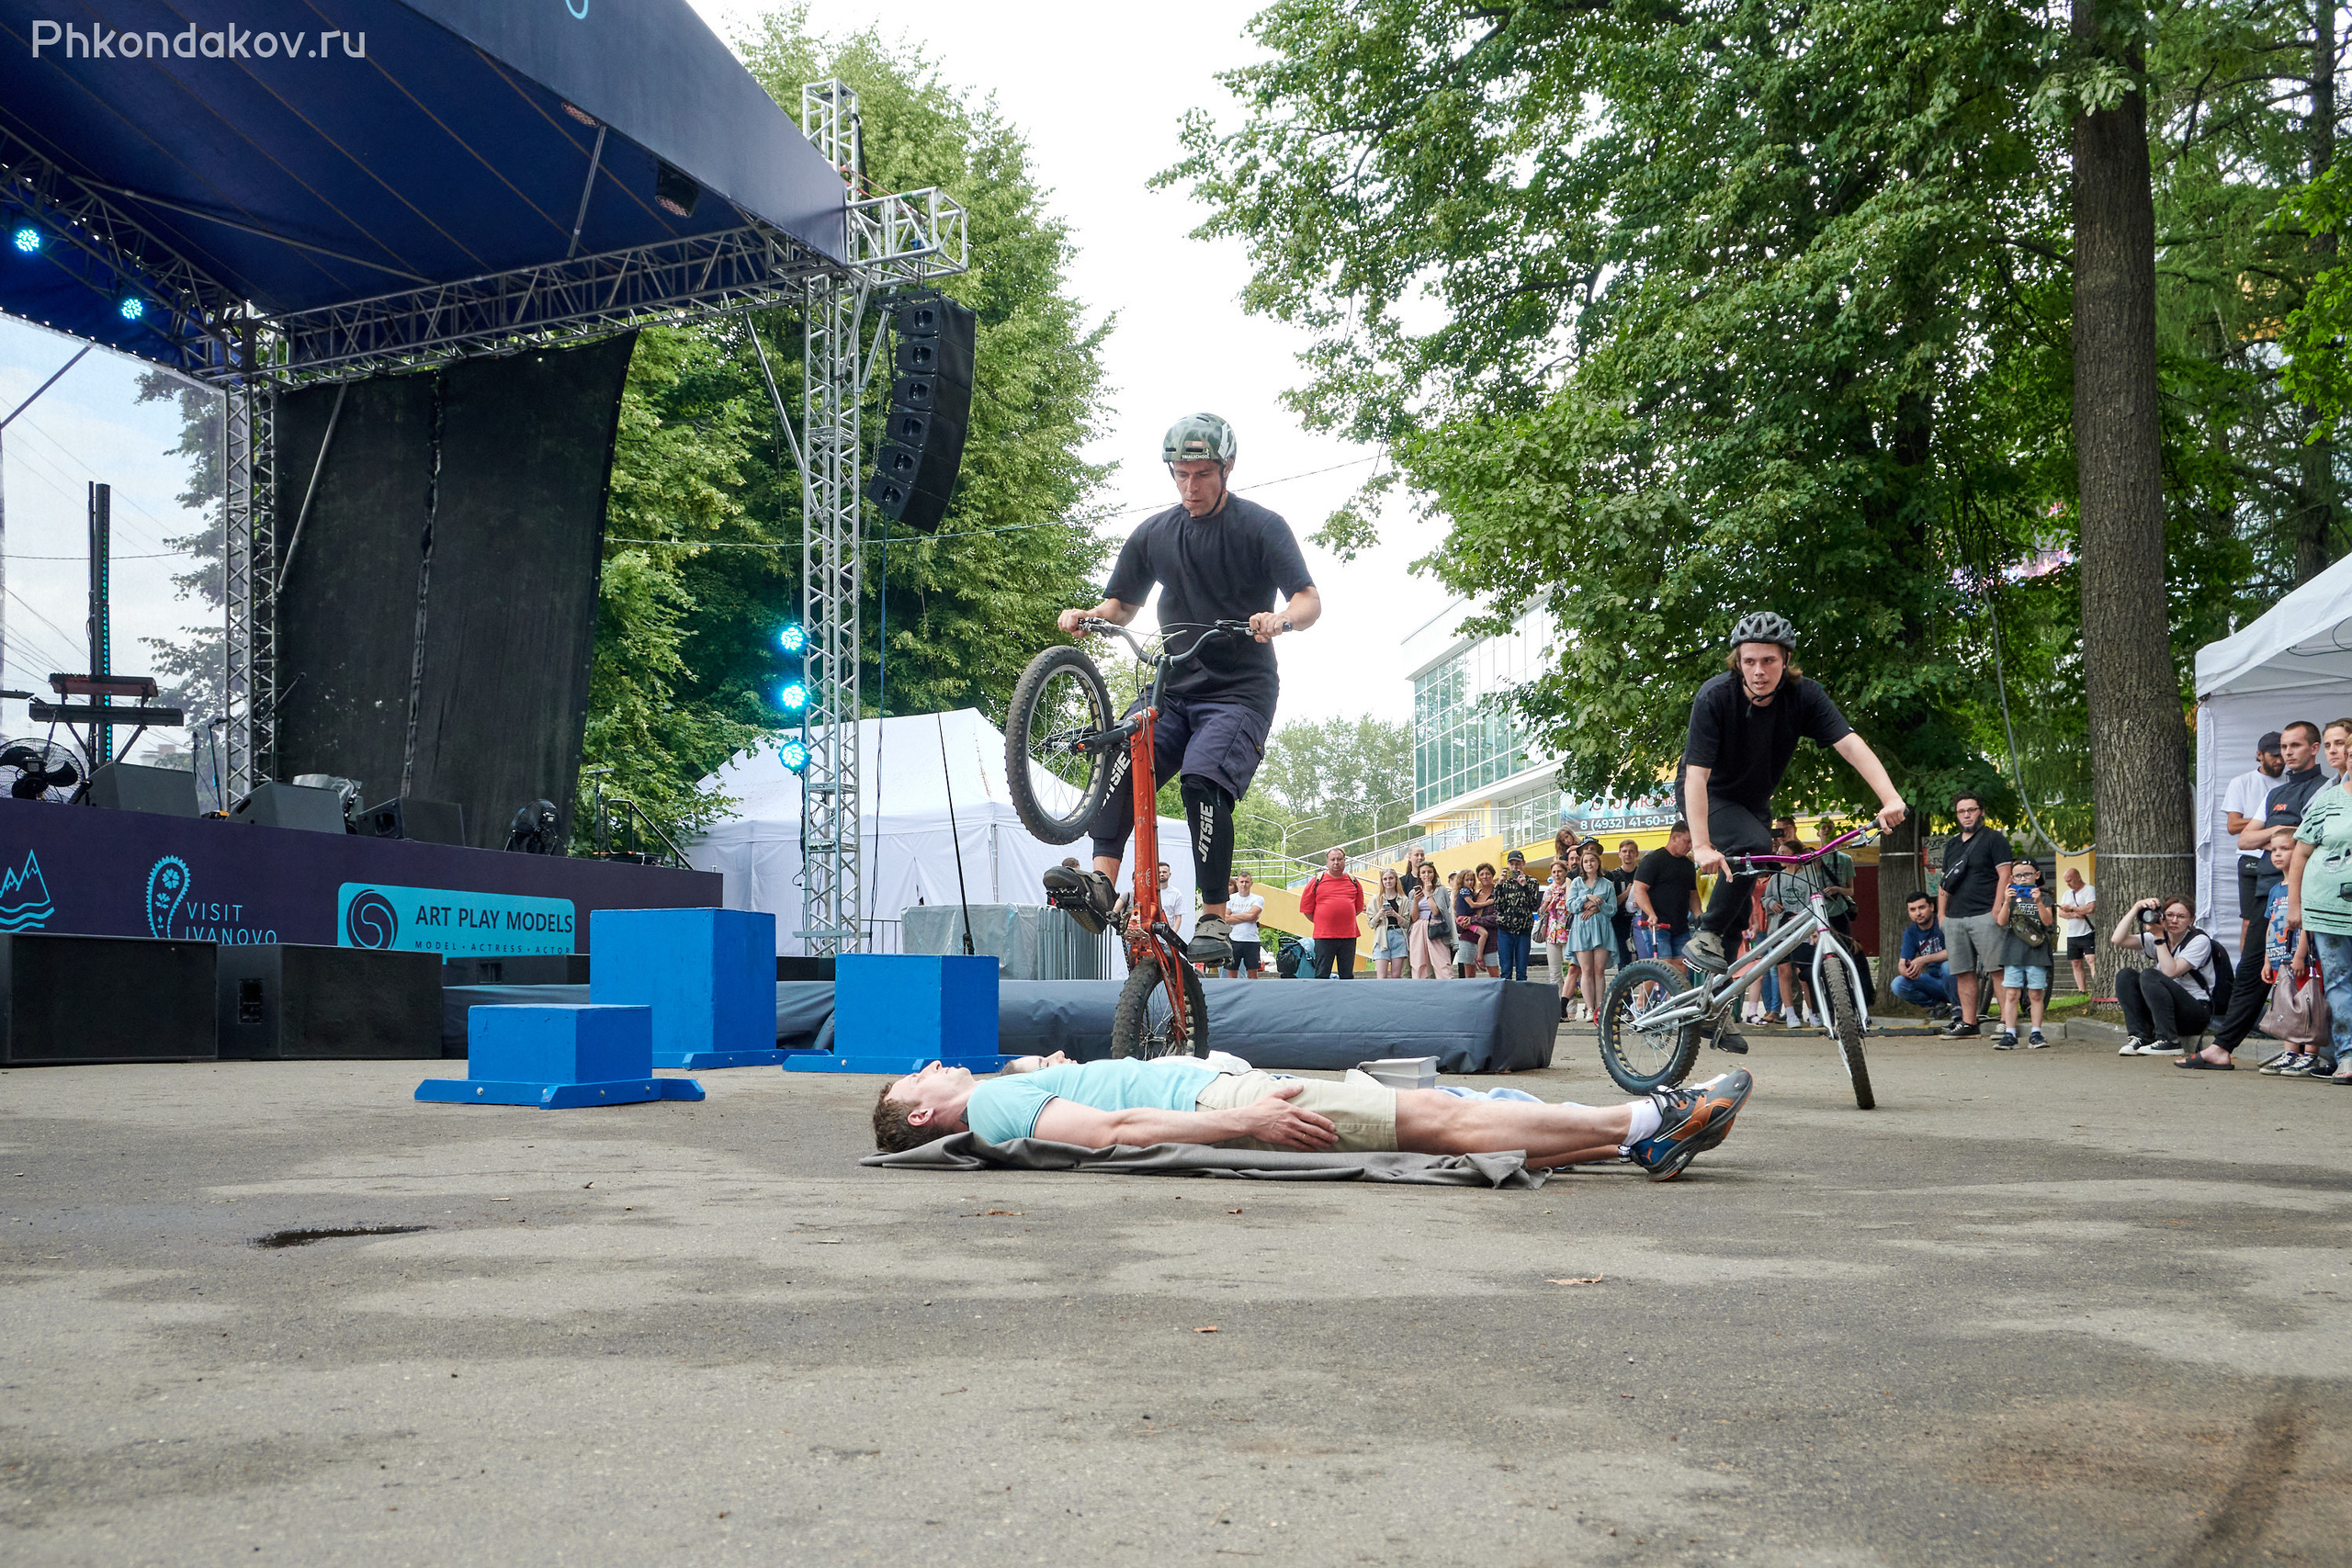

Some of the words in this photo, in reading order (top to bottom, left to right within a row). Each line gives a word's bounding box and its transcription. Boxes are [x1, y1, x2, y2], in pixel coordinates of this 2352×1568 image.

[1580, 820, 1588, 830] 8
[1590, 818, 1626, 829] (4932)
[1629, 815, 1676, 827] 41-60-13
[187, 901, 243, 921] VISIT
[415, 906, 451, 927] ART
[459, 908, 500, 930] PLAY
[507, 911, 572, 933] MODELS
[186, 926, 277, 945] IVANOVO
[415, 941, 457, 951] MODEL
[471, 943, 522, 953] ACTRESS
[536, 946, 571, 954] ACTOR
